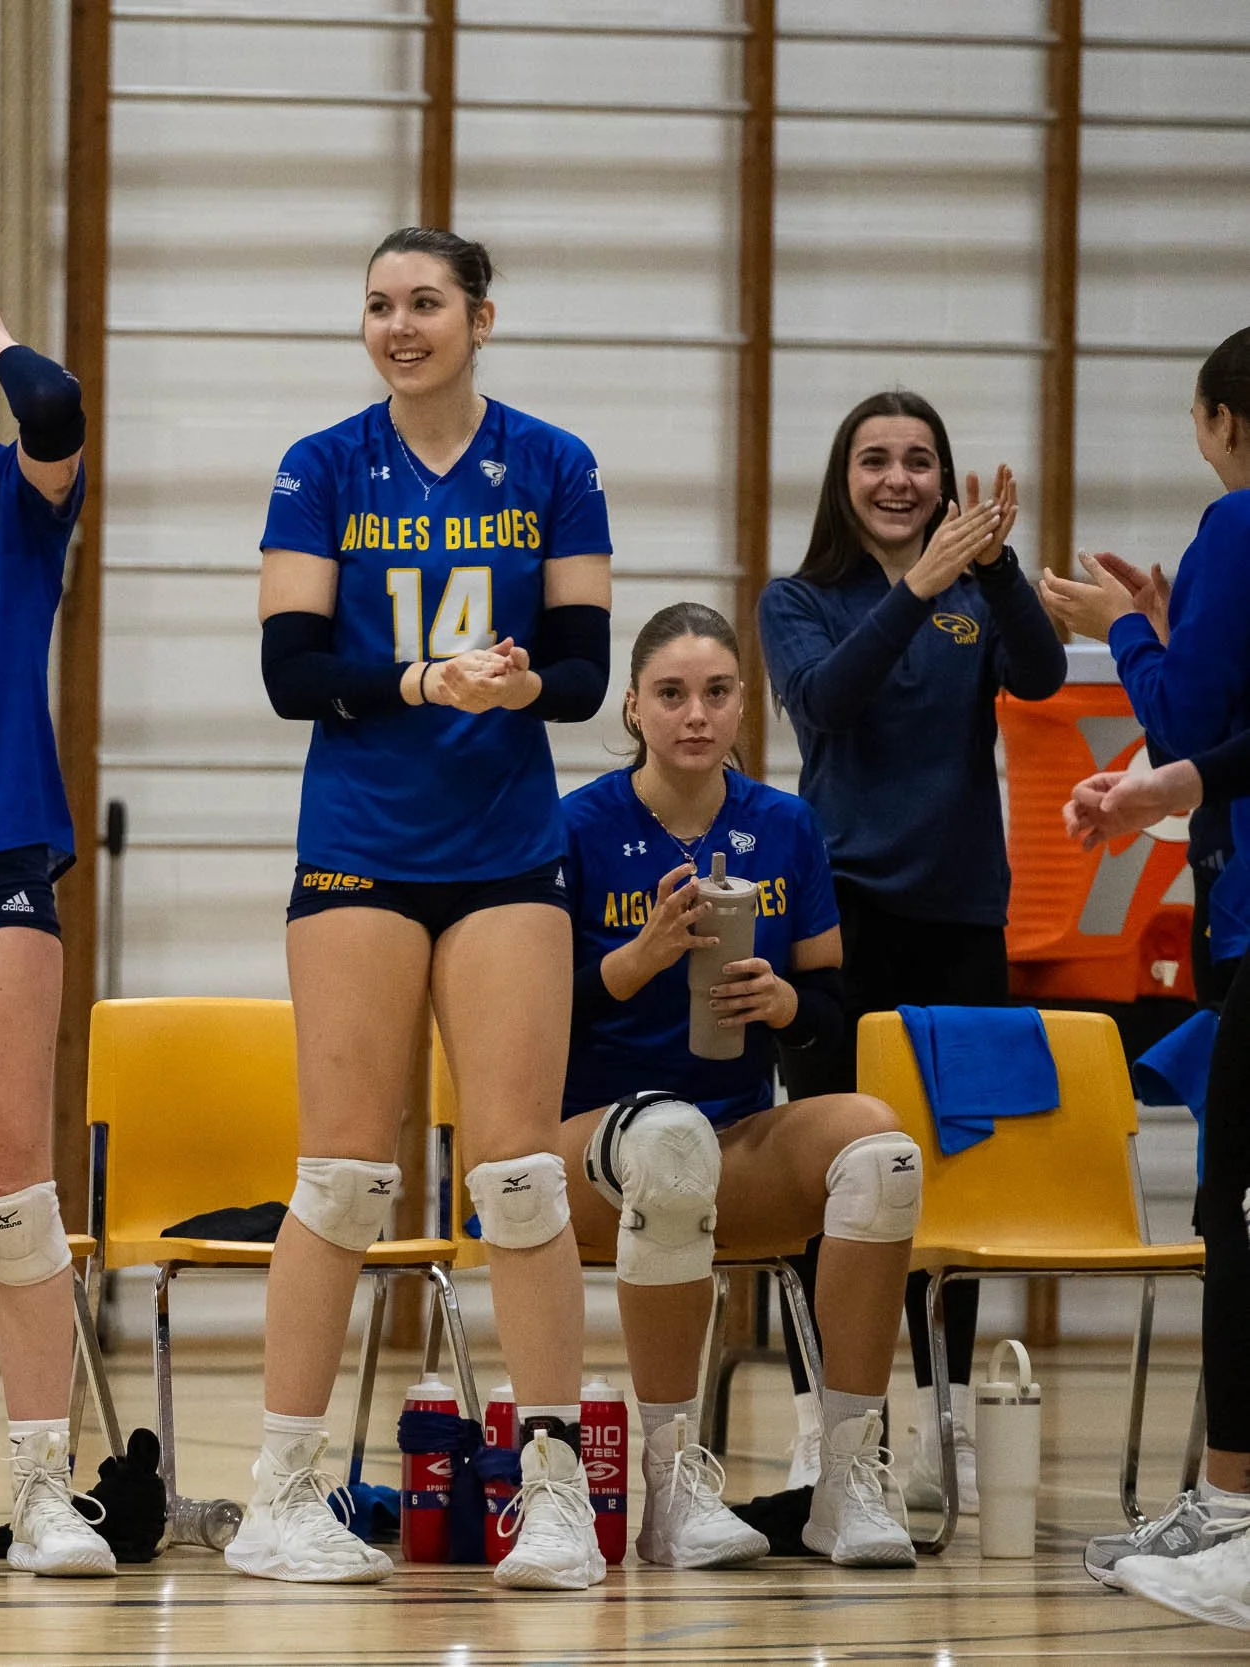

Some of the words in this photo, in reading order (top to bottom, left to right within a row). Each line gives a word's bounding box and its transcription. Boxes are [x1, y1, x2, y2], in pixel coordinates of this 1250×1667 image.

[341, 512, 431, 551] AIGLES
[445, 509, 541, 549] BLEUES
[386, 566, 498, 664] 14
[303, 871, 374, 891] aigles
[1, 902, 35, 913] adidas
[581, 1447, 621, 1458] TEEL
[426, 1484, 450, 1492] SPORT
[411, 1494, 418, 1505] 6
[608, 1498, 617, 1509] 12
